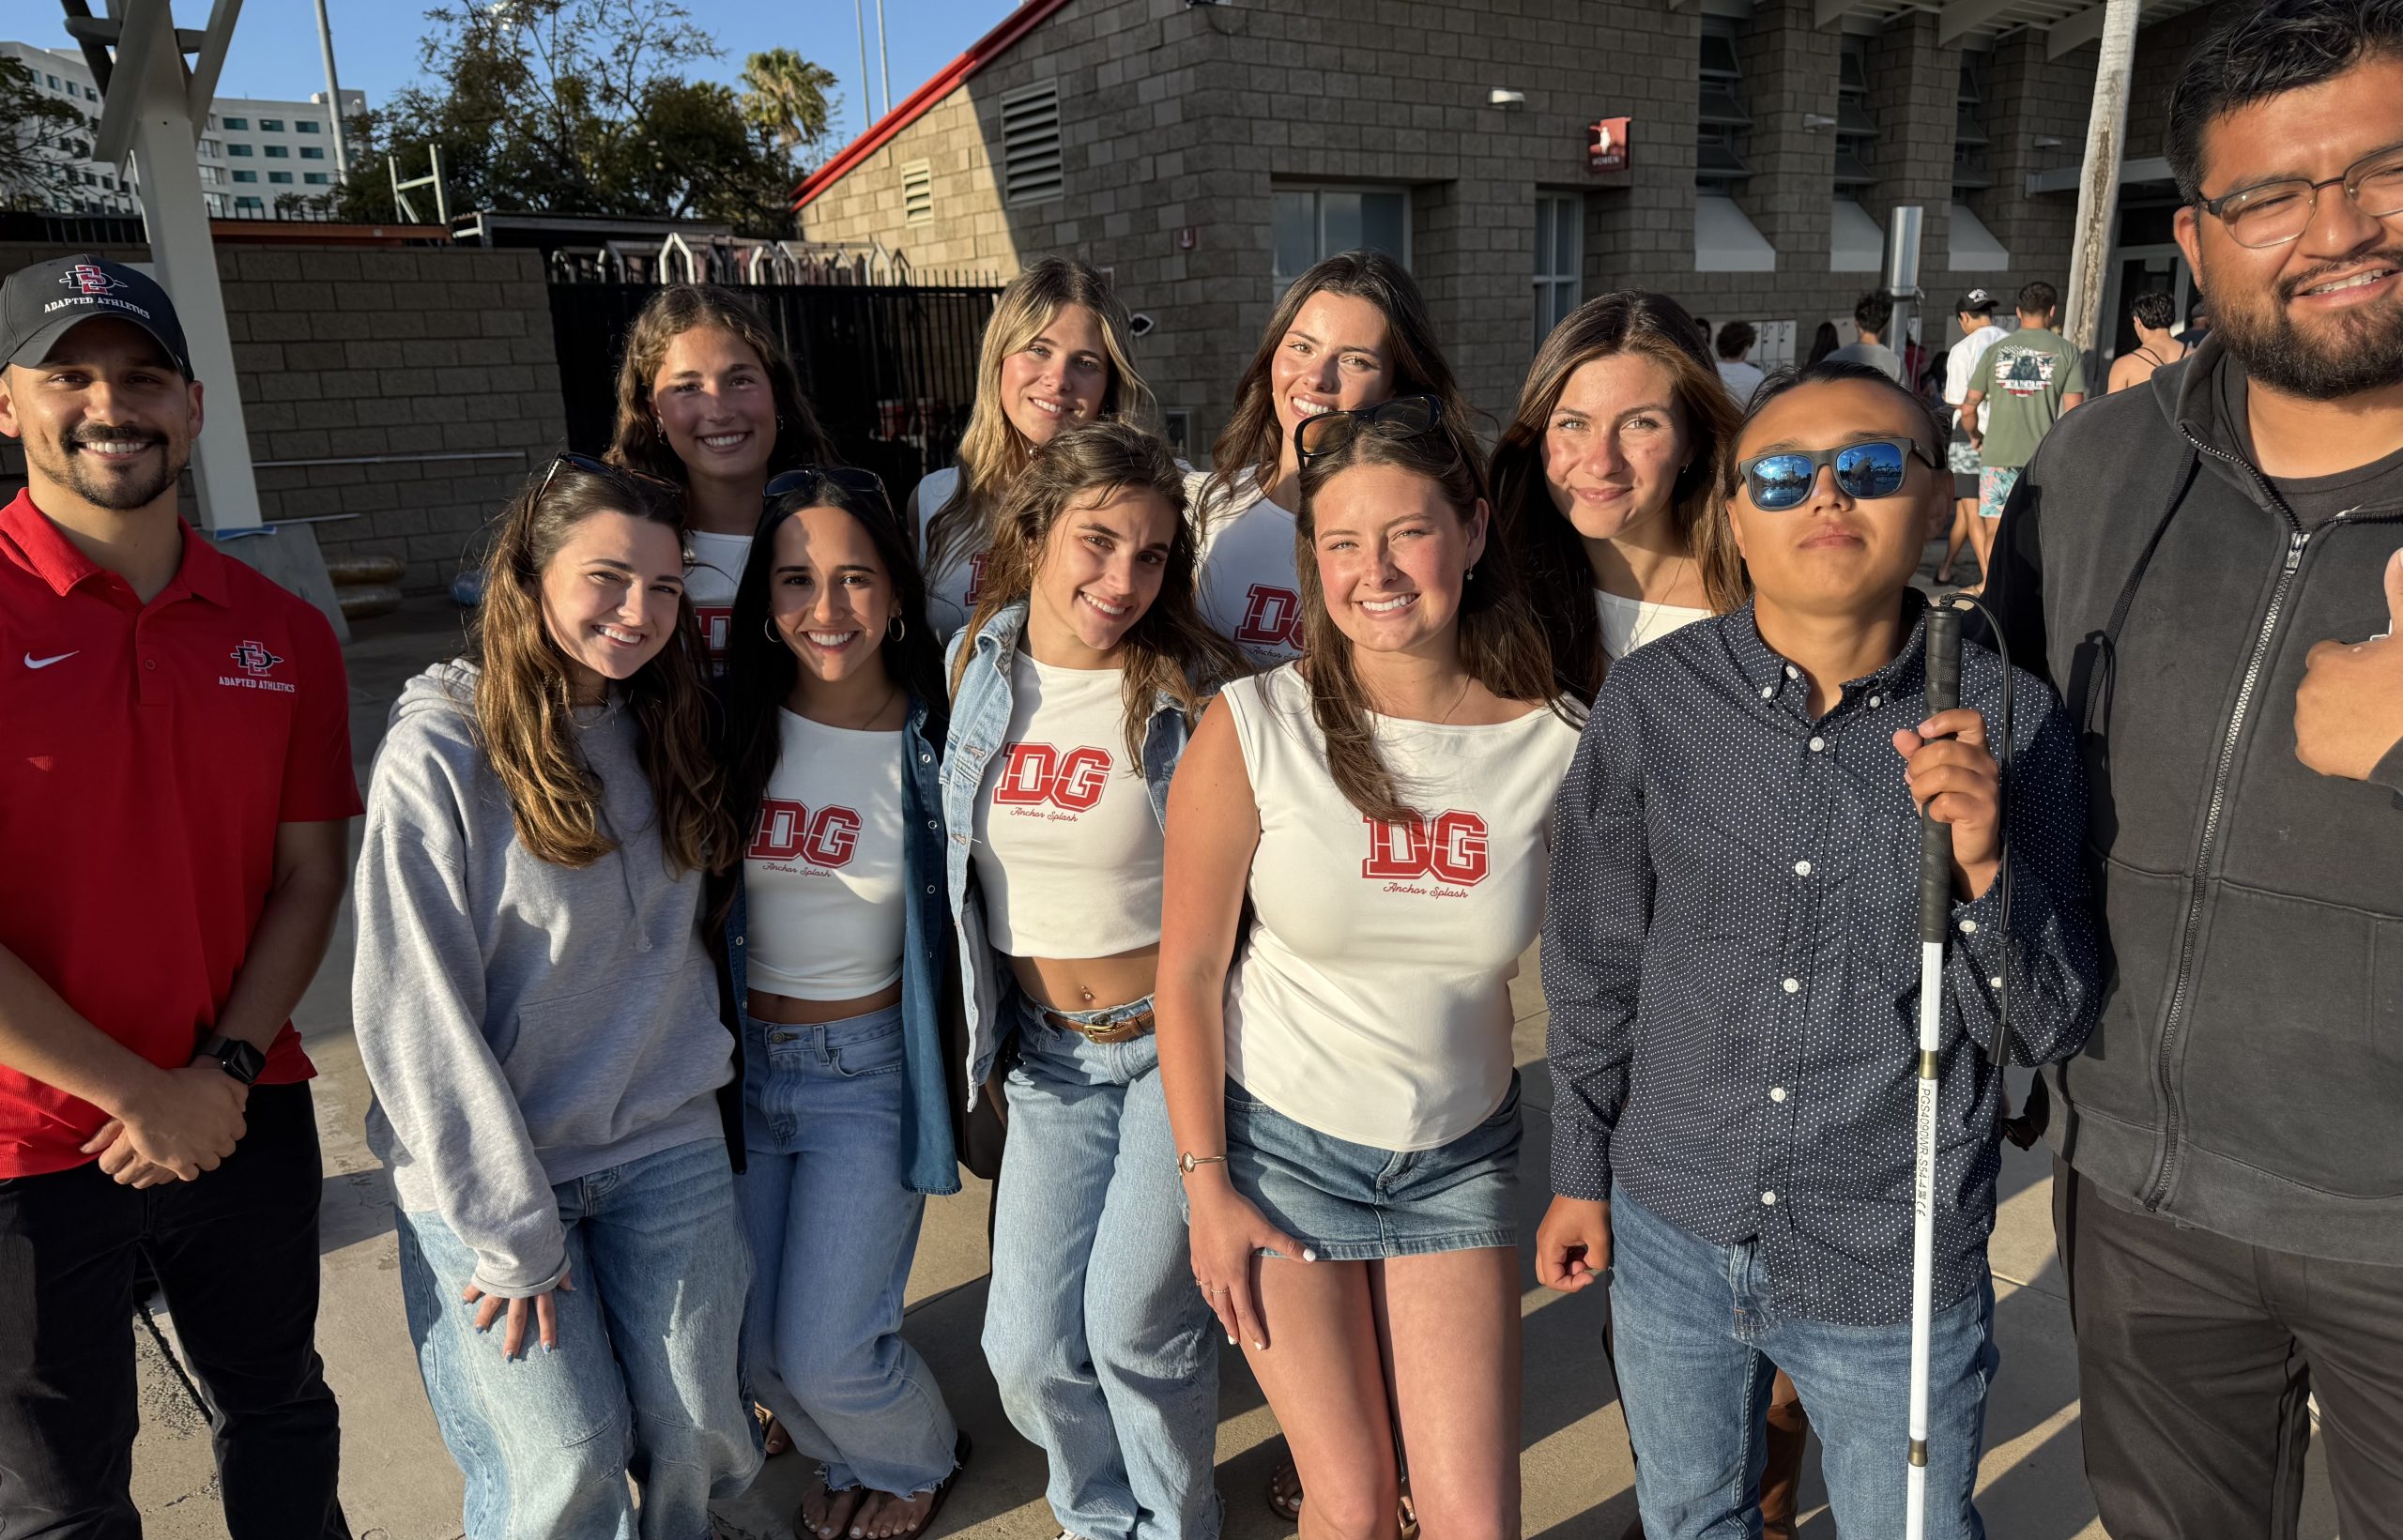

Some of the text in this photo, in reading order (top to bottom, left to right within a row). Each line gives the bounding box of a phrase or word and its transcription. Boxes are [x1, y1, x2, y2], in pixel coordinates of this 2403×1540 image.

[44, 297, 150, 319] ADAPTED ATHLETICS
[1234, 583, 1305, 651] D
[219, 676, 296, 693] ADAPTED ATHLETICS
[994, 742, 1114, 814] DG
[1010, 807, 1079, 822] Anchor Splash
[744, 797, 863, 869] DG
[1362, 806, 1491, 887] DG
[762, 861, 832, 877] Anchor Splash
[1383, 881, 1469, 900] Anchor Splash
